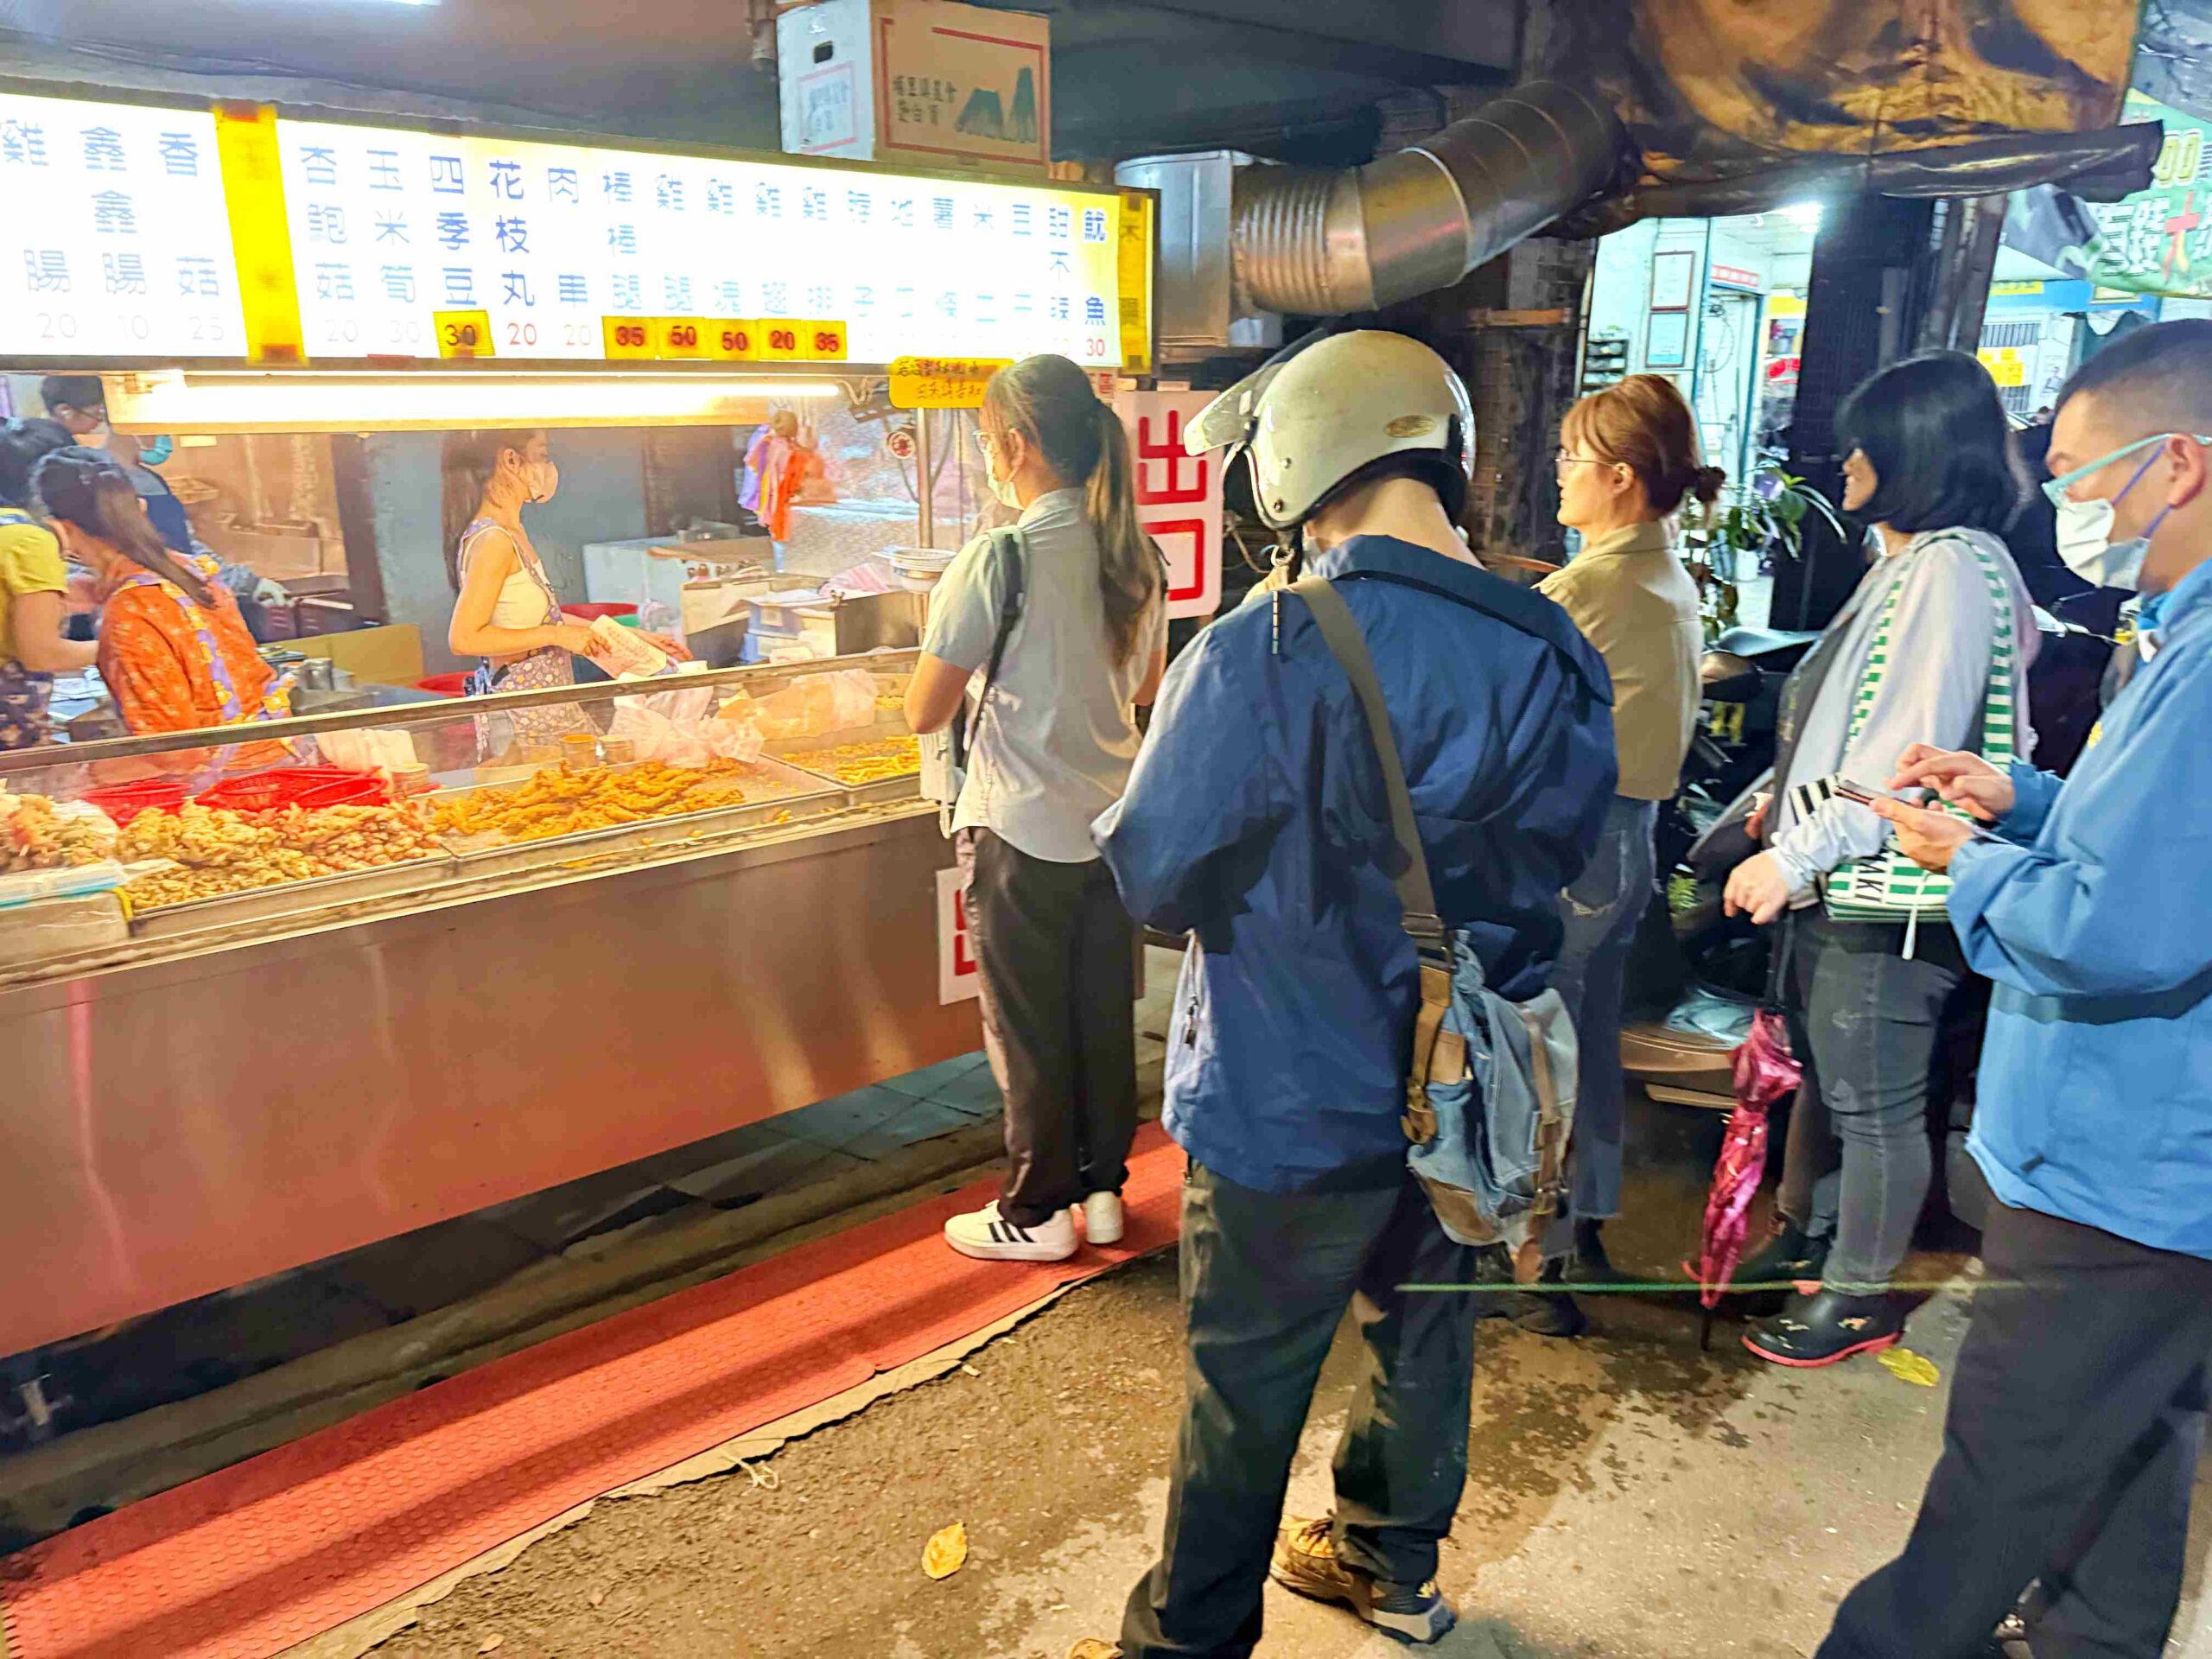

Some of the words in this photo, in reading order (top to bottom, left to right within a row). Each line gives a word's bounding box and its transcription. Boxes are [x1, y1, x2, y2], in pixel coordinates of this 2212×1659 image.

[79, 126, 146, 294] 鑫鑫腸
[159, 132, 219, 296] 香菇
[299, 145, 354, 301] 杏鮑菇
[366, 149, 416, 302] 玉米筍
[429, 156, 478, 306] 四季豆
[489, 159, 535, 307] 花枝丸
[1083, 208, 1107, 326] 魷魚
[444, 324, 476, 346] 30
[507, 322, 537, 346] 20
[563, 324, 592, 346] 20
[615, 326, 645, 346] 35
[671, 324, 697, 346] 50
[722, 331, 748, 352] 50
[770, 329, 795, 351] 20
[816, 332, 840, 353] 35
[1086, 338, 1106, 359] 30
[1137, 410, 1208, 601] 出口
